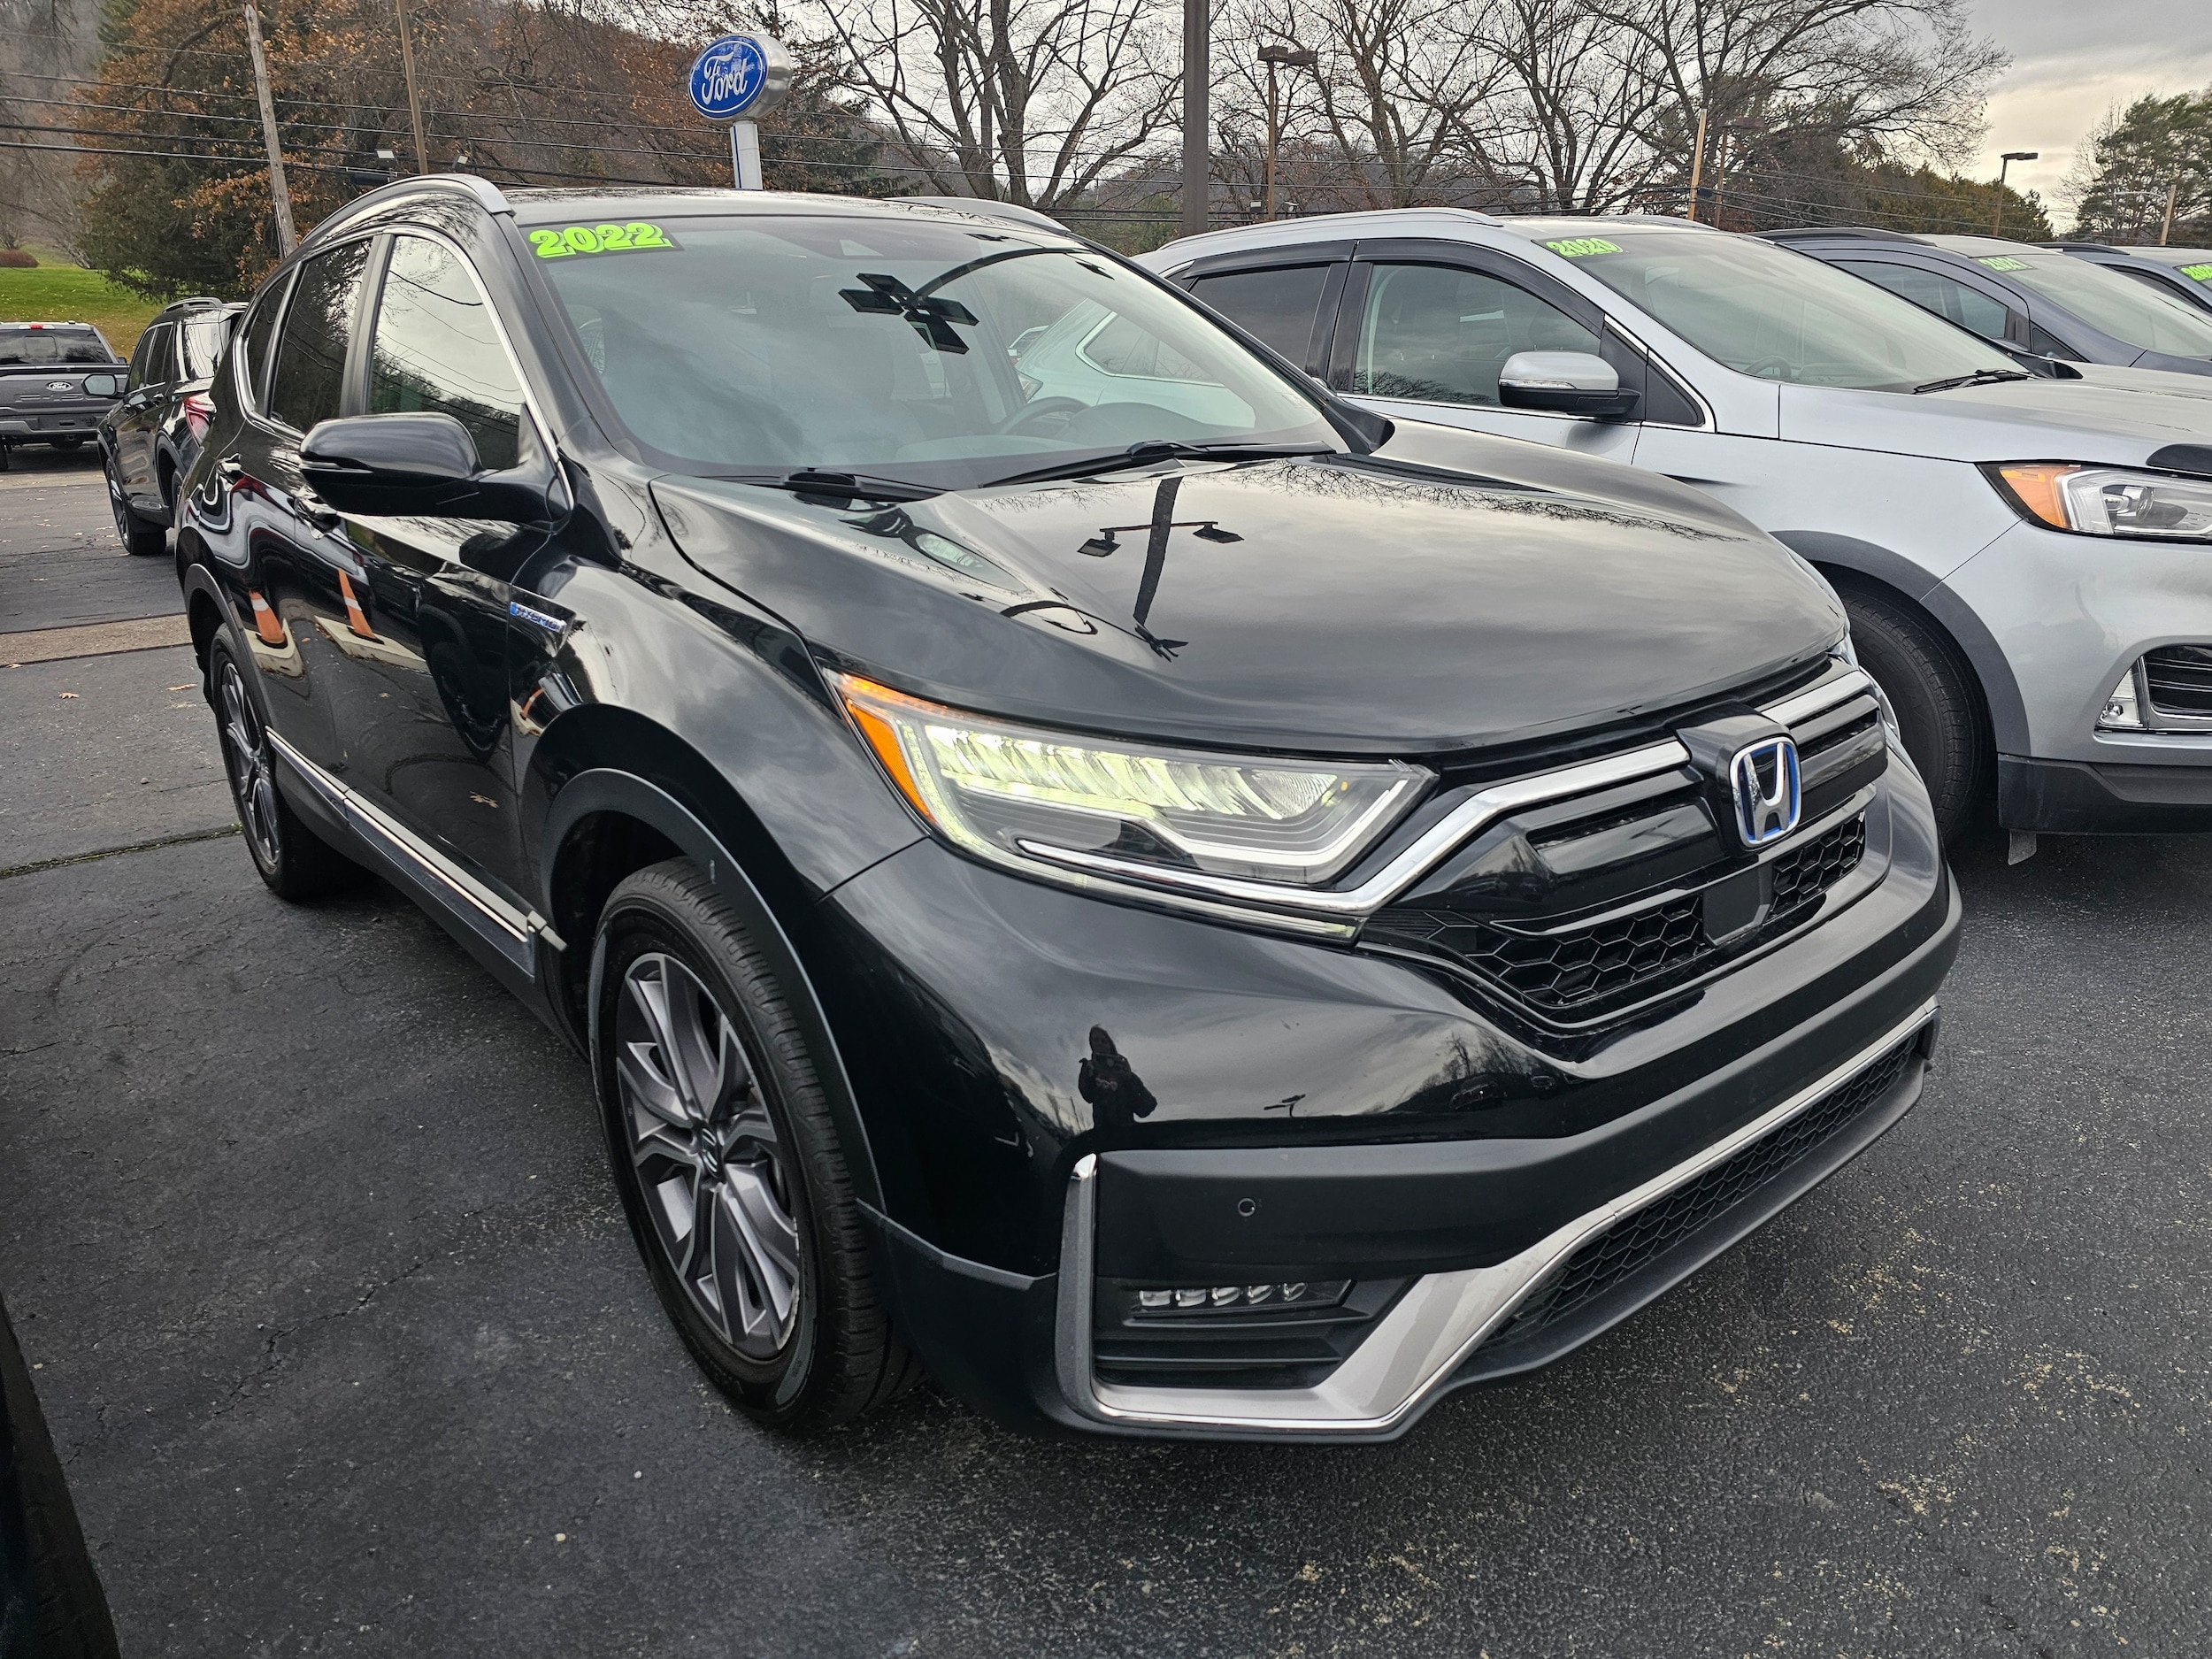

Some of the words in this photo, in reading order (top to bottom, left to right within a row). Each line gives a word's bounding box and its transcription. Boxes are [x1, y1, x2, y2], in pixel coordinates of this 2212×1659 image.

[702, 51, 749, 104] Ford
[529, 222, 675, 258] 2022
[1546, 237, 1624, 257] 2020
